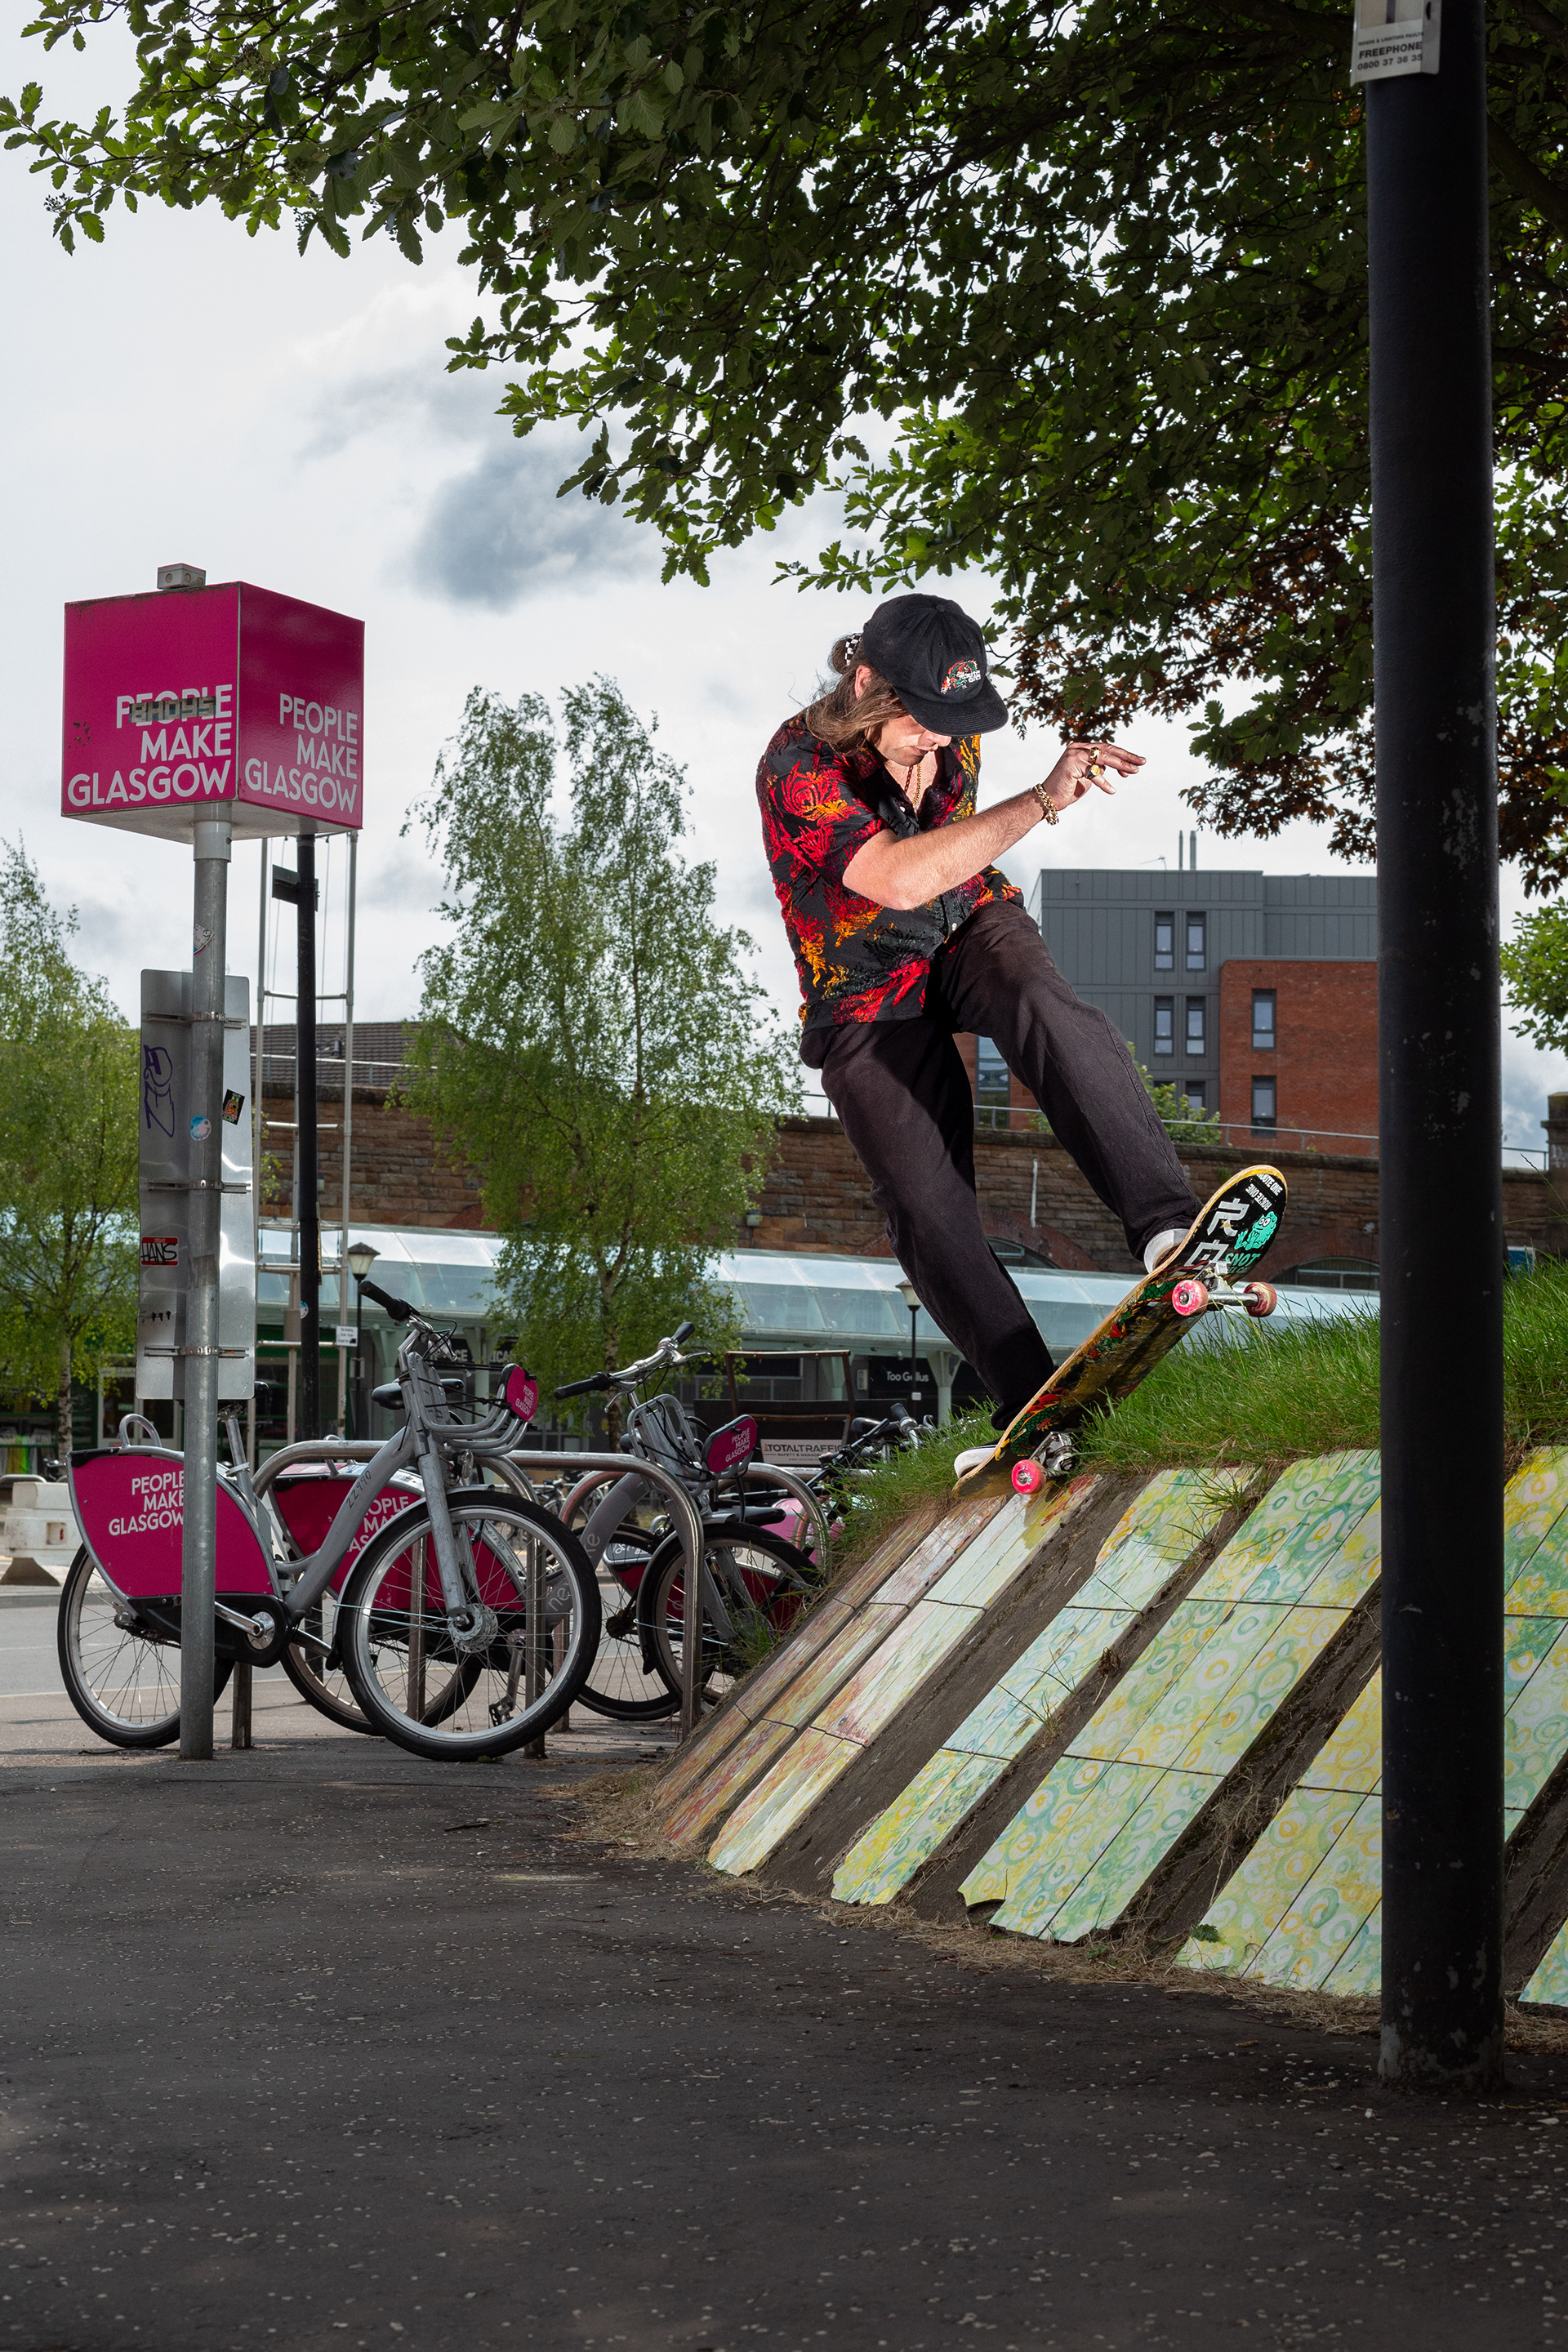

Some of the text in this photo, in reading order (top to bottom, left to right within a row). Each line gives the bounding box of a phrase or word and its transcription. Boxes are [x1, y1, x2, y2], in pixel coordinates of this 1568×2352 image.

[1359, 42, 1423, 59] FREEPHONE
[1357, 60, 1380, 70] 0800
[1383, 58, 1394, 66] 37
[1396, 56, 1409, 65] 36
[279, 693, 358, 745] PEOPLE
[140, 722, 232, 764] MAKE
[296, 734, 358, 780] MAKE
[68, 760, 231, 807] GLASGOW
[245, 758, 358, 813] GLASGOW
[1245, 1183, 1260, 1198] ONE
[1270, 1182, 1284, 1196] ONE
[140, 1241, 177, 1265] HANS
[1225, 1252, 1261, 1267] SNOT
[886, 1371, 929, 1382] Too Gllus
[523, 1385, 534, 1400] PEOPLE
[524, 1395, 532, 1408] MAKE
[516, 1398, 530, 1415] GLASGOW
[732, 1428, 750, 1444] PEOPLE
[735, 1435, 750, 1449] MAKE
[725, 1442, 750, 1463] GLASGOW
[131, 1471, 185, 1495] PEOPLE
[345, 1470, 372, 1509] 22990
[143, 1489, 185, 1512] MAKE
[365, 1496, 409, 1516] OPLE
[109, 1510, 184, 1536] GLASGOW
